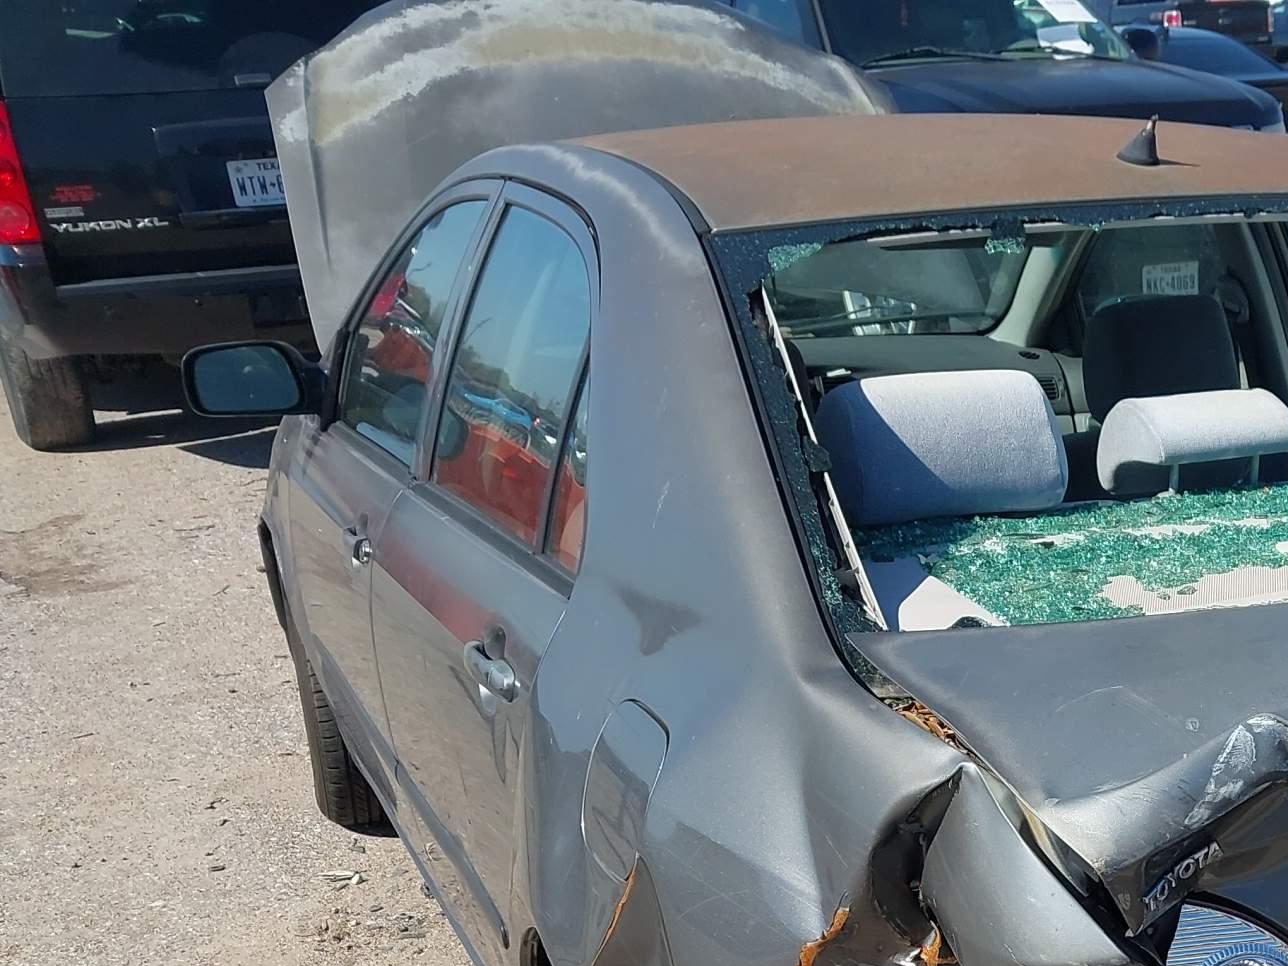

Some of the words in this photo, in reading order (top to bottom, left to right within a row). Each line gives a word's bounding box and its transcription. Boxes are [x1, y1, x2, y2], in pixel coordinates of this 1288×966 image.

[256, 161, 280, 172] TEX
[50, 218, 132, 233] YUKON
[136, 216, 169, 228] XL
[1143, 841, 1224, 911] TOYOTA
